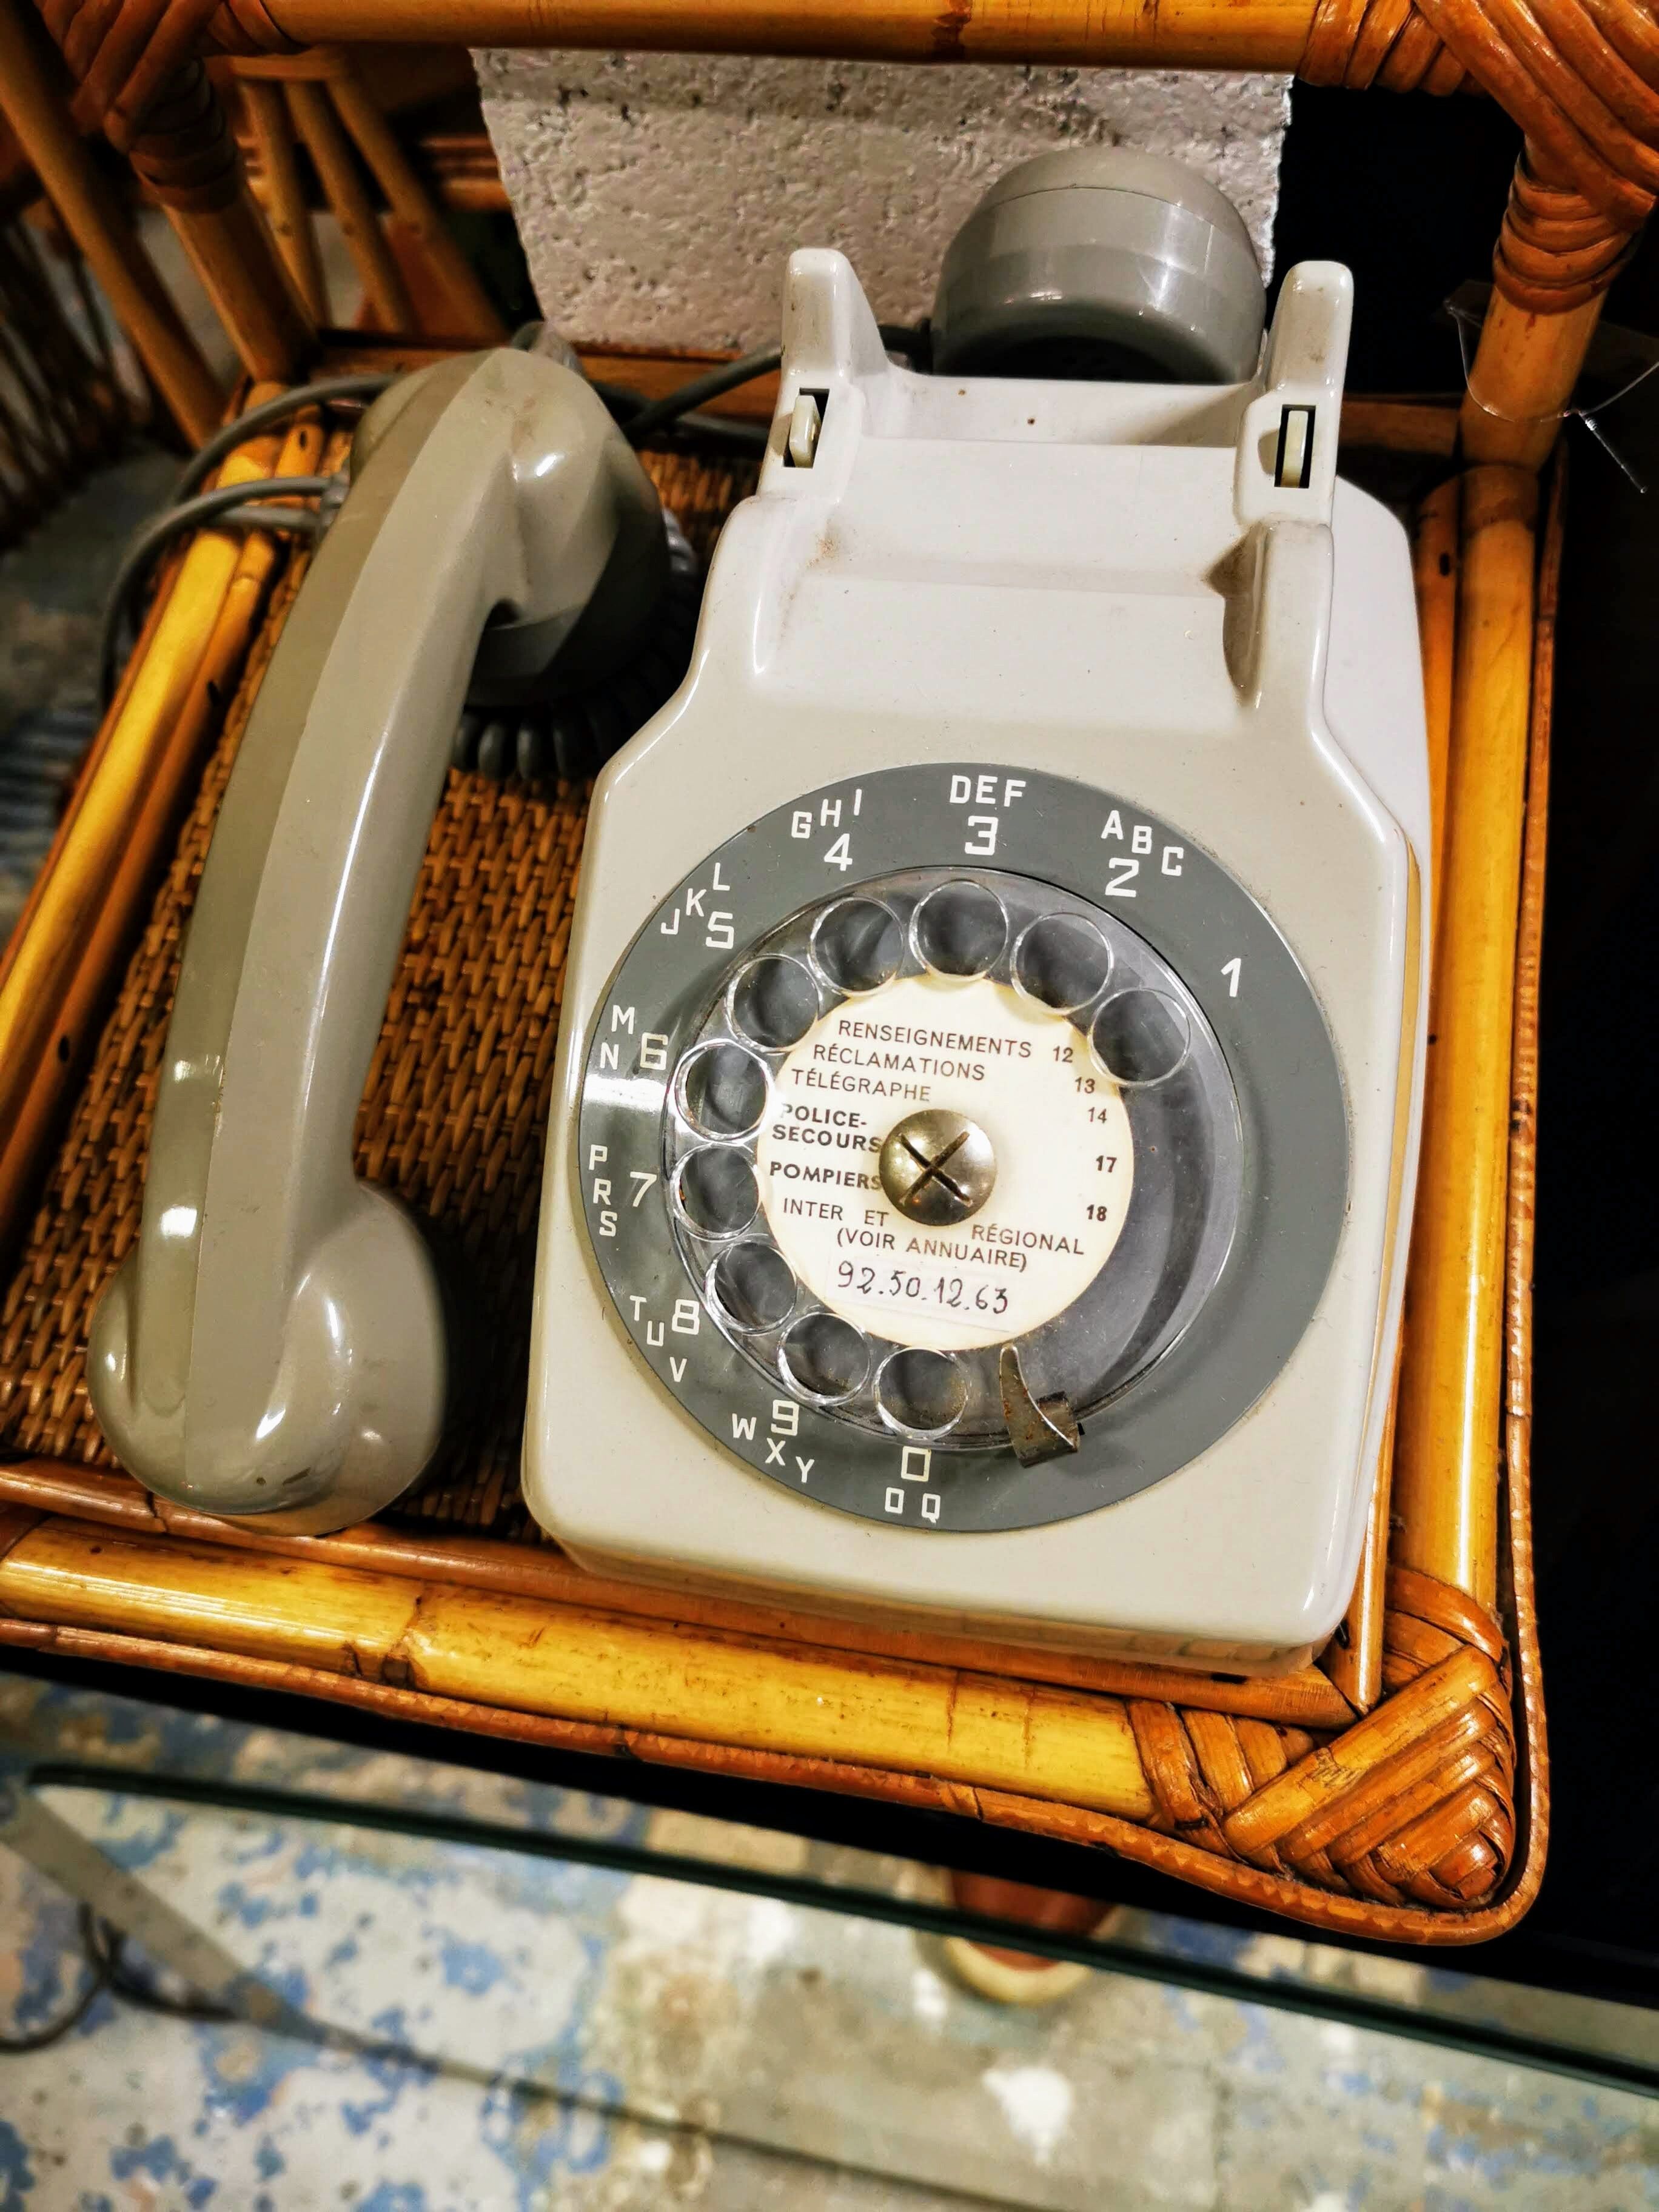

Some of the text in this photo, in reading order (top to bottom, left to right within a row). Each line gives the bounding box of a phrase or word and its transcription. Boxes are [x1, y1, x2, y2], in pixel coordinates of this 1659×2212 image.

[950, 775, 1026, 807] DEF
[791, 789, 862, 839] GHI
[823, 833, 853, 871] 4
[965, 816, 999, 856] 3
[1101, 810, 1184, 876] ABC
[1105, 857, 1139, 897] 2
[705, 911, 734, 949] 5
[1221, 958, 1241, 997] 1
[640, 1032, 668, 1070] 6
[839, 1020, 1073, 1063] RENSEIGNEMENTS 12
[814, 1044, 1095, 1094] RÉCLAMATIONS 13
[791, 1068, 1107, 1124] TÉLÉGRAPHE 14
[772, 1124, 1116, 1173] SECOURS 17
[630, 1171, 657, 1207] 7
[769, 1161, 1107, 1222] POMPIERS 18
[783, 1198, 1085, 1255] INTER ET RÉGIONAL
[837, 1228, 1027, 1273] (VOIR ANNUAIRE)
[838, 1261, 1008, 1315] 92.50.12.63
[672, 1299, 700, 1335] 8
[771, 1399, 799, 1436] 9
[900, 1446, 931, 1482] 0
